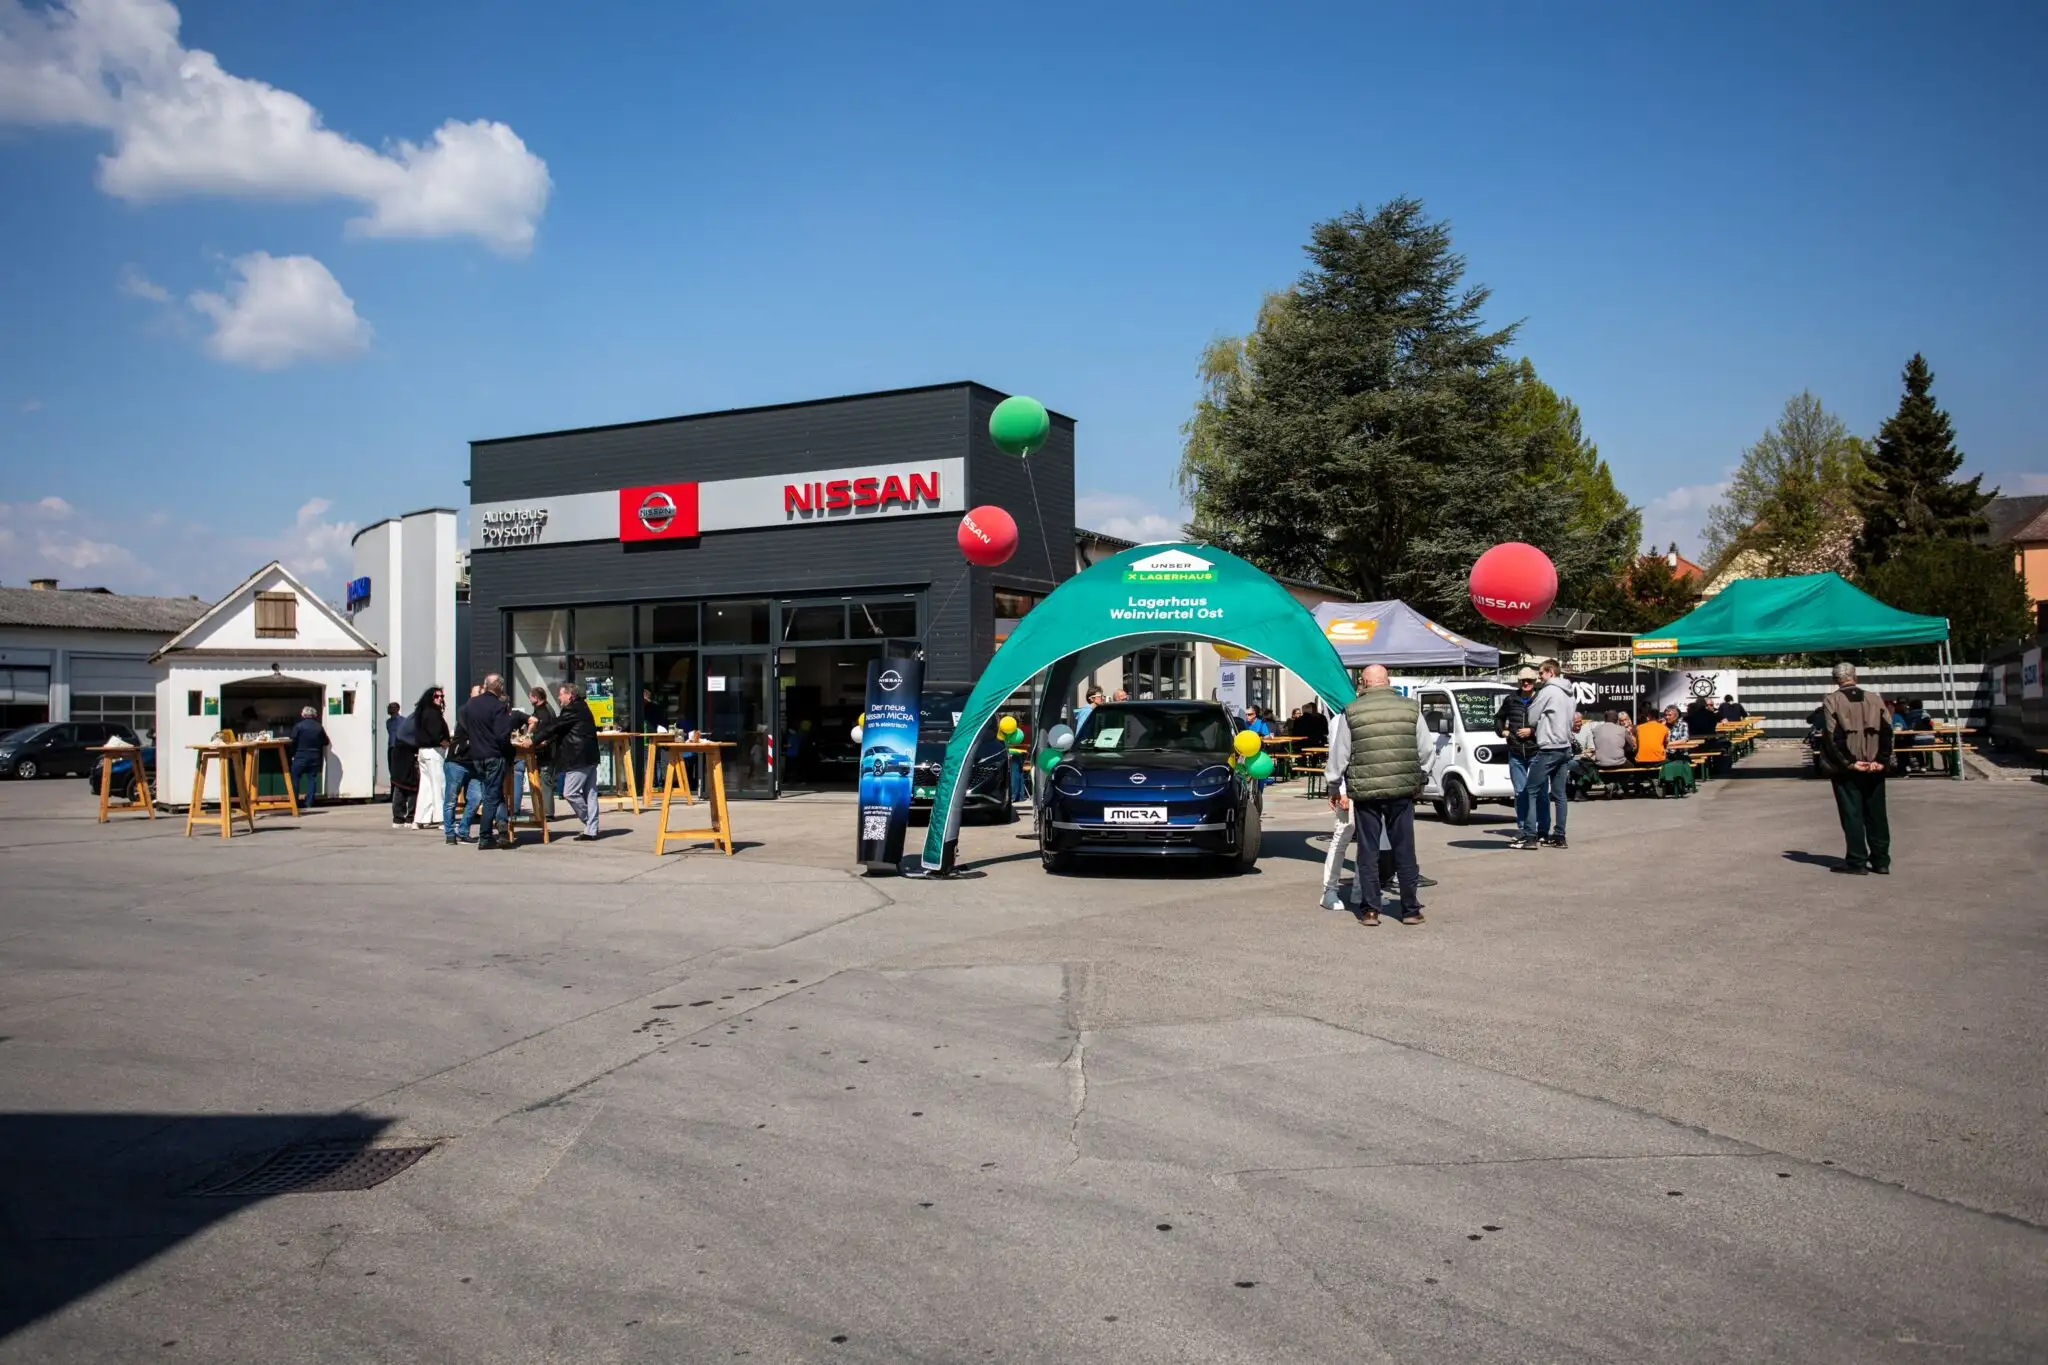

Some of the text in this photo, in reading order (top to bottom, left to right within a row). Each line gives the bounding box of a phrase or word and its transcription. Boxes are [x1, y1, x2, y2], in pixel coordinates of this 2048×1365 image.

[784, 471, 938, 512] NISSAN
[482, 508, 546, 523] Autohaus
[640, 507, 673, 517] NISSAN
[481, 521, 540, 539] Poysdorf
[962, 513, 992, 545] ISSAN
[1139, 573, 1213, 581] LAGERHAUS
[1128, 596, 1208, 609] Lagerhaus
[1472, 594, 1531, 610] NISSAN
[1110, 608, 1224, 620] Weinviertel Ost
[586, 660, 612, 670] NISSA
[1599, 684, 1646, 694] DETAILING
[884, 704, 906, 712] neue
[886, 712, 914, 721] MICRA
[1110, 810, 1162, 819] MICRA
